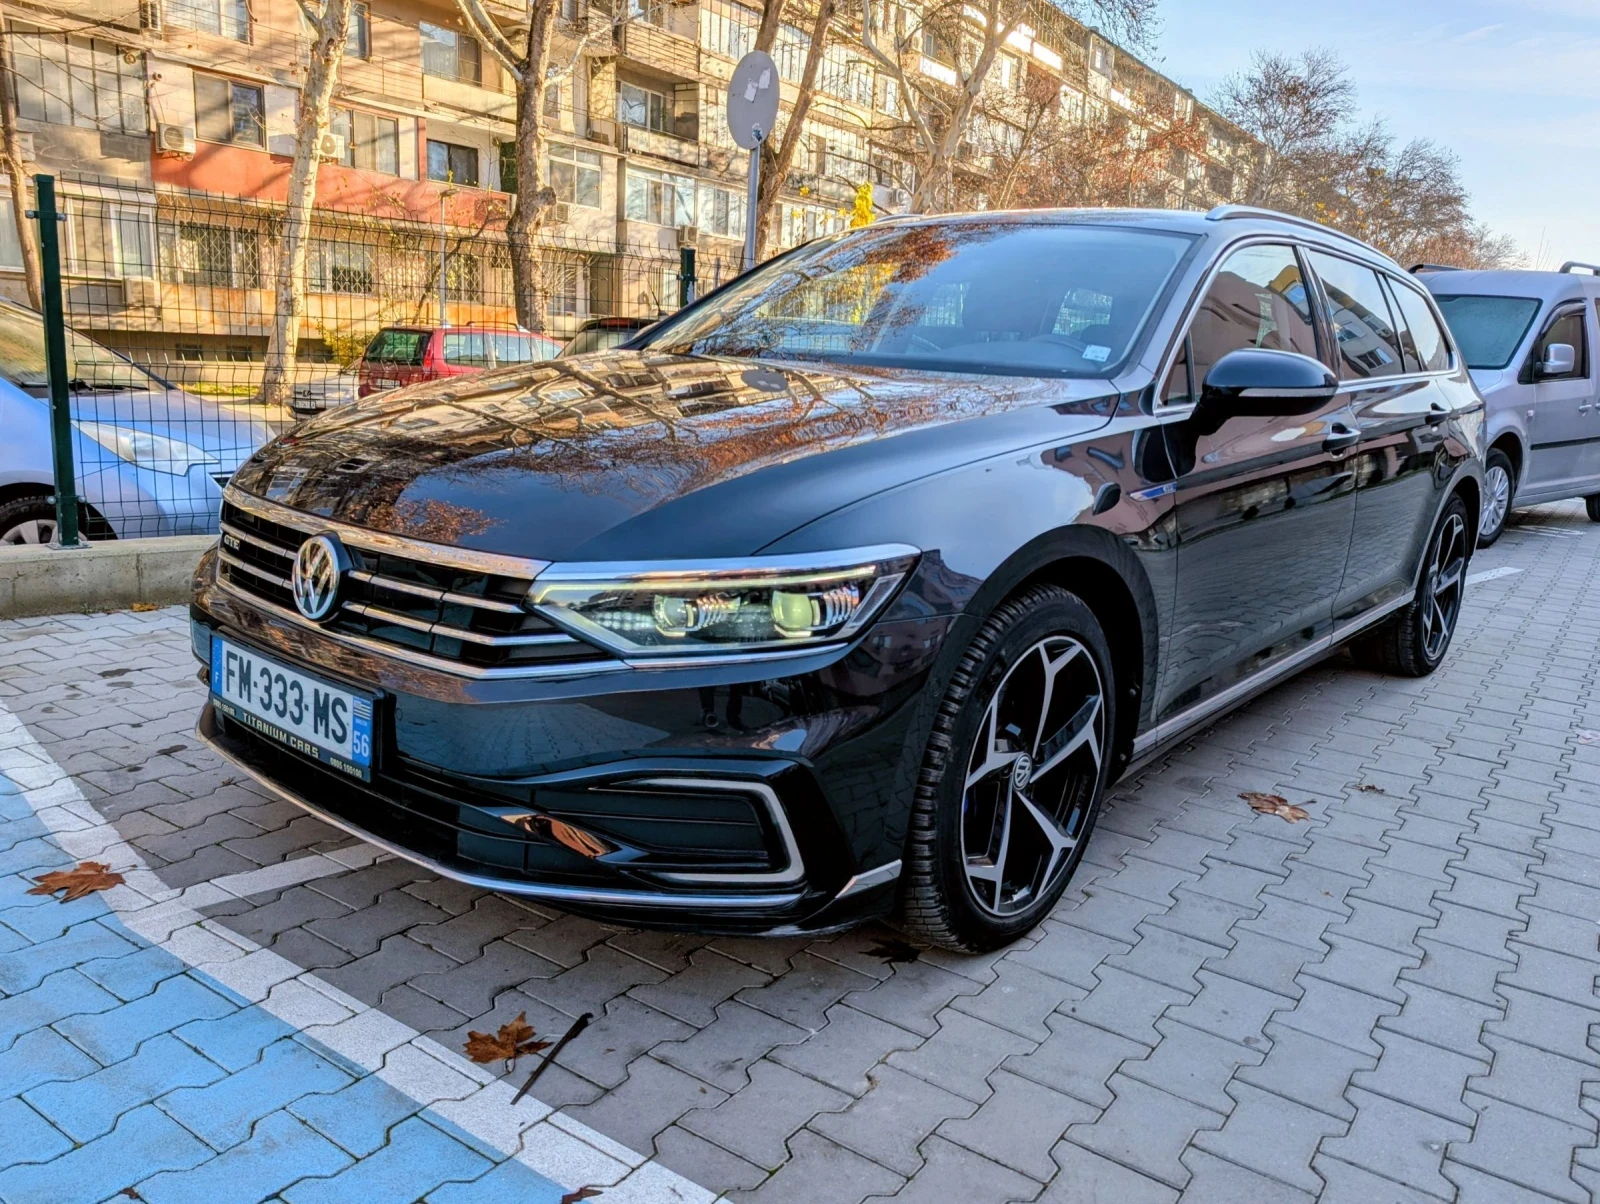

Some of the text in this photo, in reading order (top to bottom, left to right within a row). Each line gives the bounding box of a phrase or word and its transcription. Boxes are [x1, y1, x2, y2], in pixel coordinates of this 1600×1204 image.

[224, 534, 240, 550] GTE
[226, 649, 348, 745] FM-333-MS
[243, 712, 319, 759] TITANIUM CARS
[353, 730, 369, 757] 56
